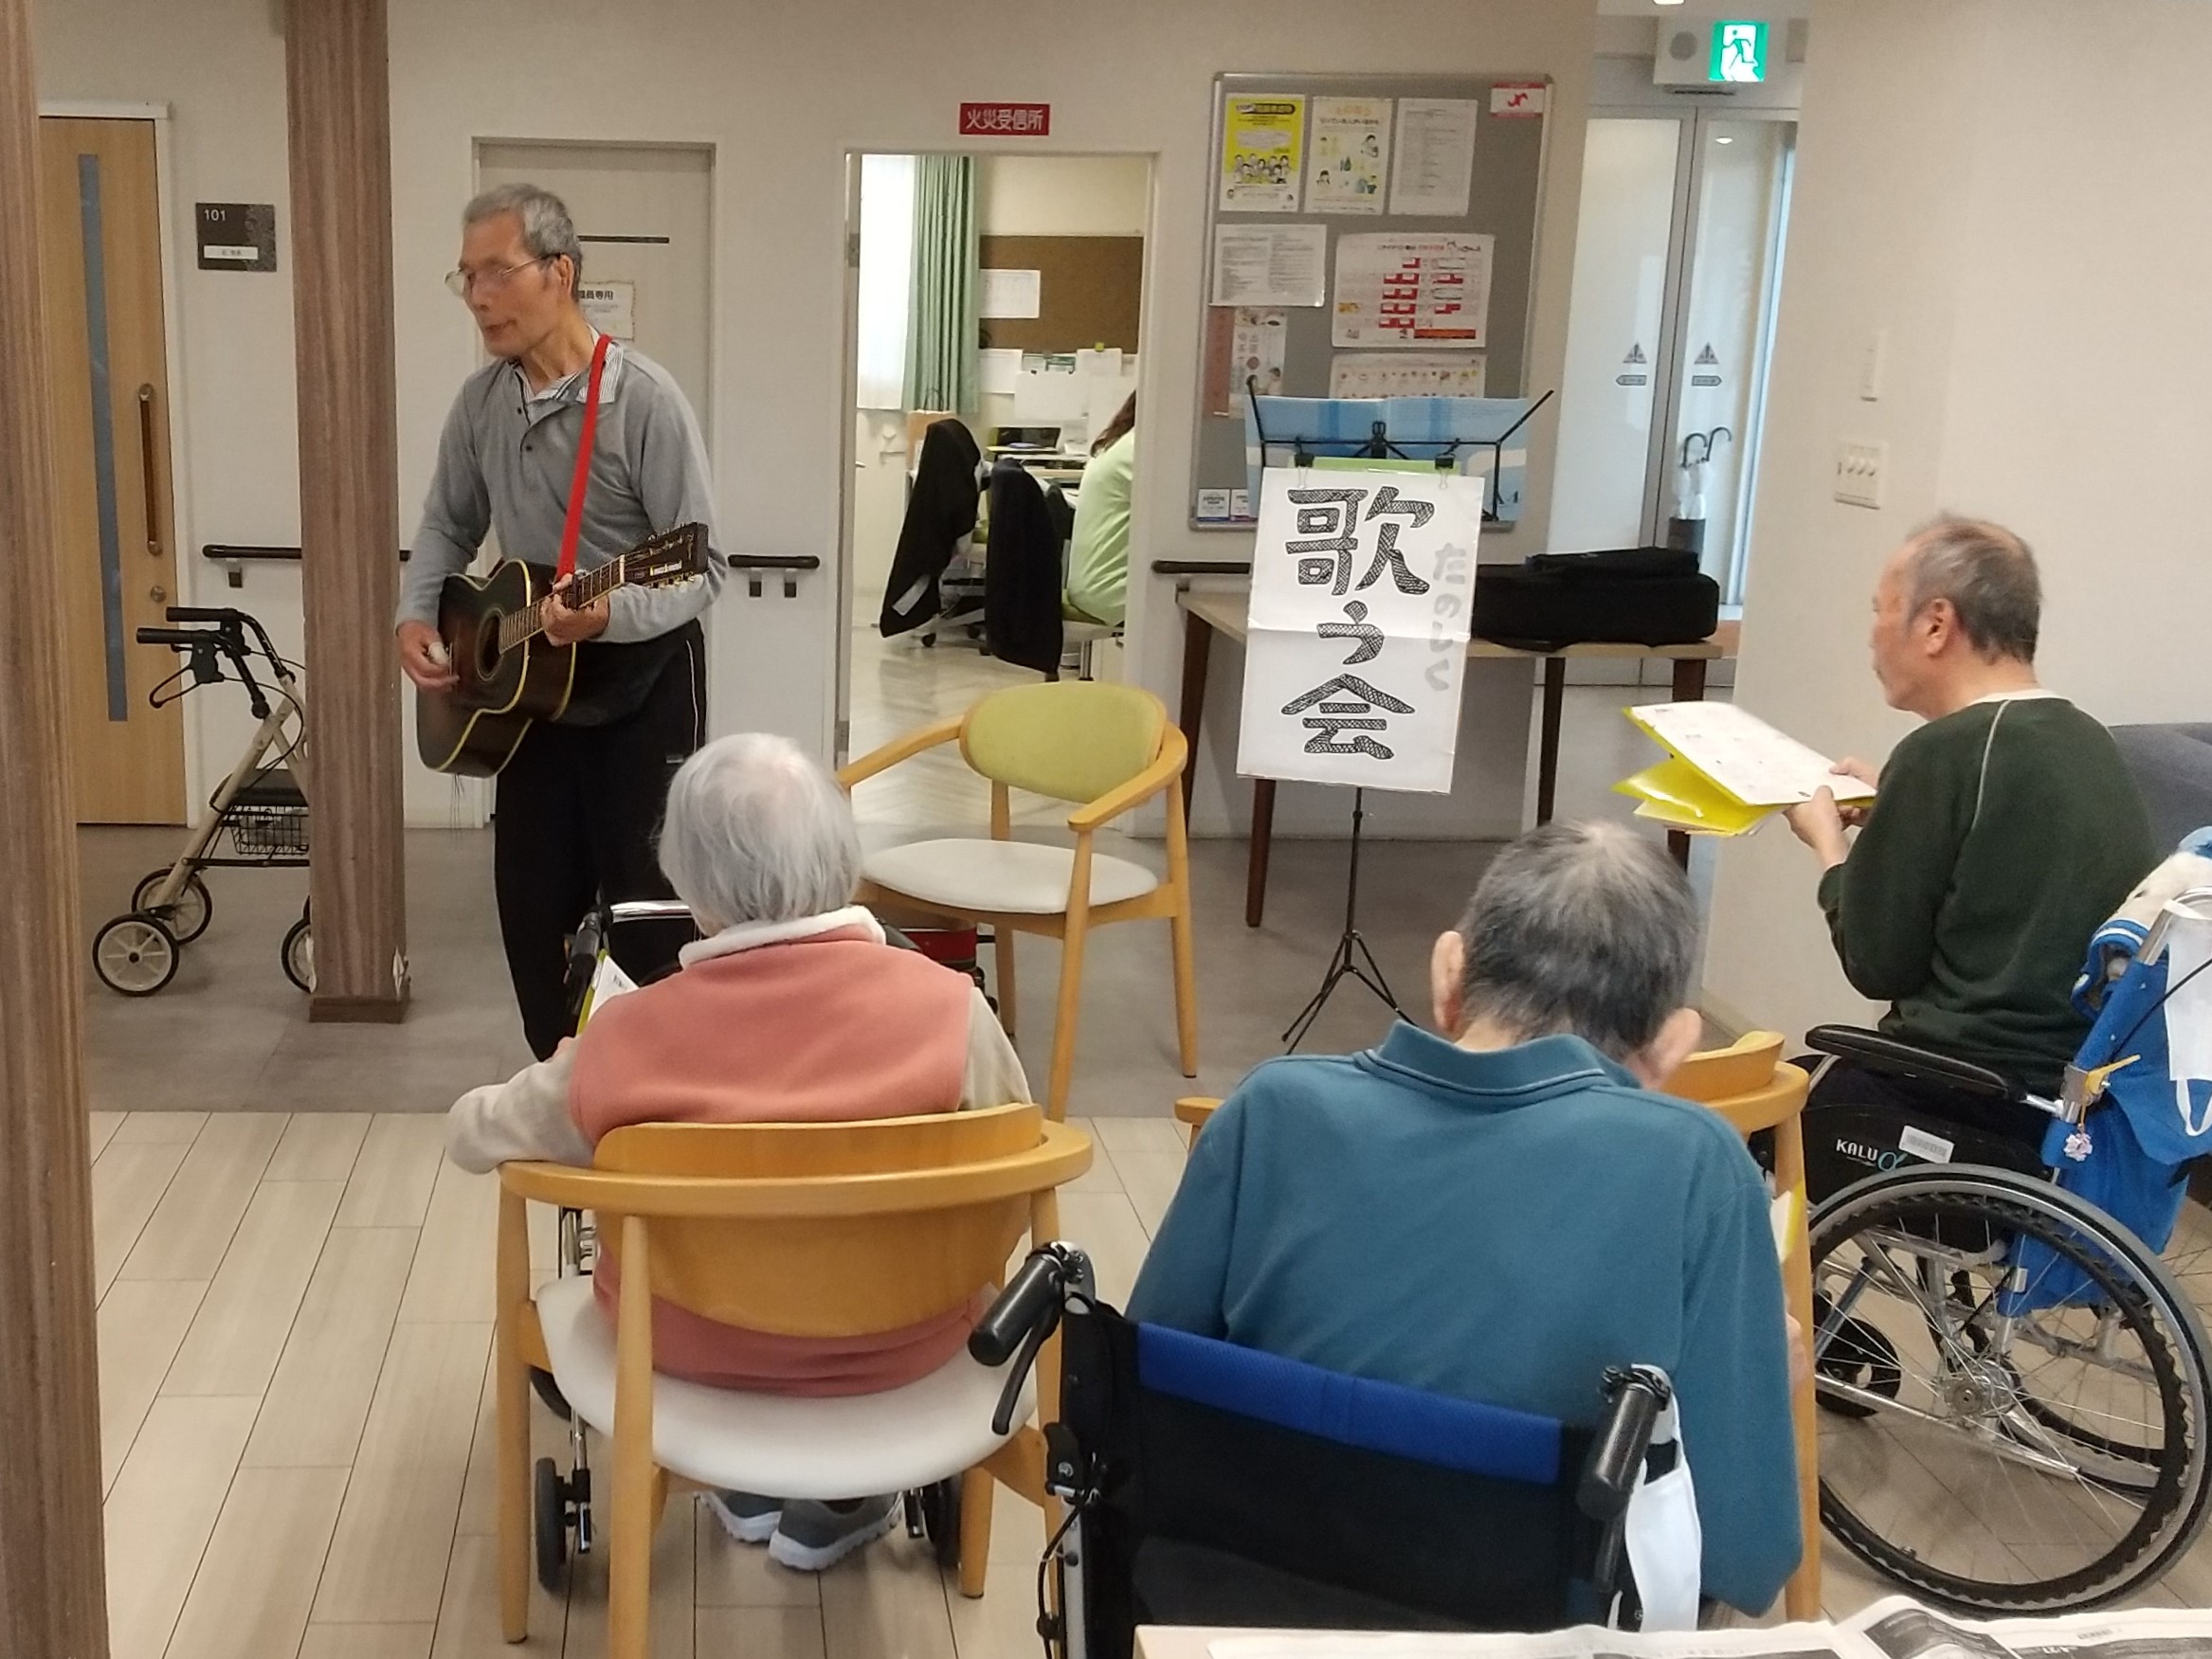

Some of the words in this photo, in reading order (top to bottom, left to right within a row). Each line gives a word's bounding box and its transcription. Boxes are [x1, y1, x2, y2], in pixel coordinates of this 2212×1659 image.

[965, 108, 1043, 131] 火災受信所
[204, 208, 226, 222] 101
[1281, 486, 1435, 760] 歌う会
